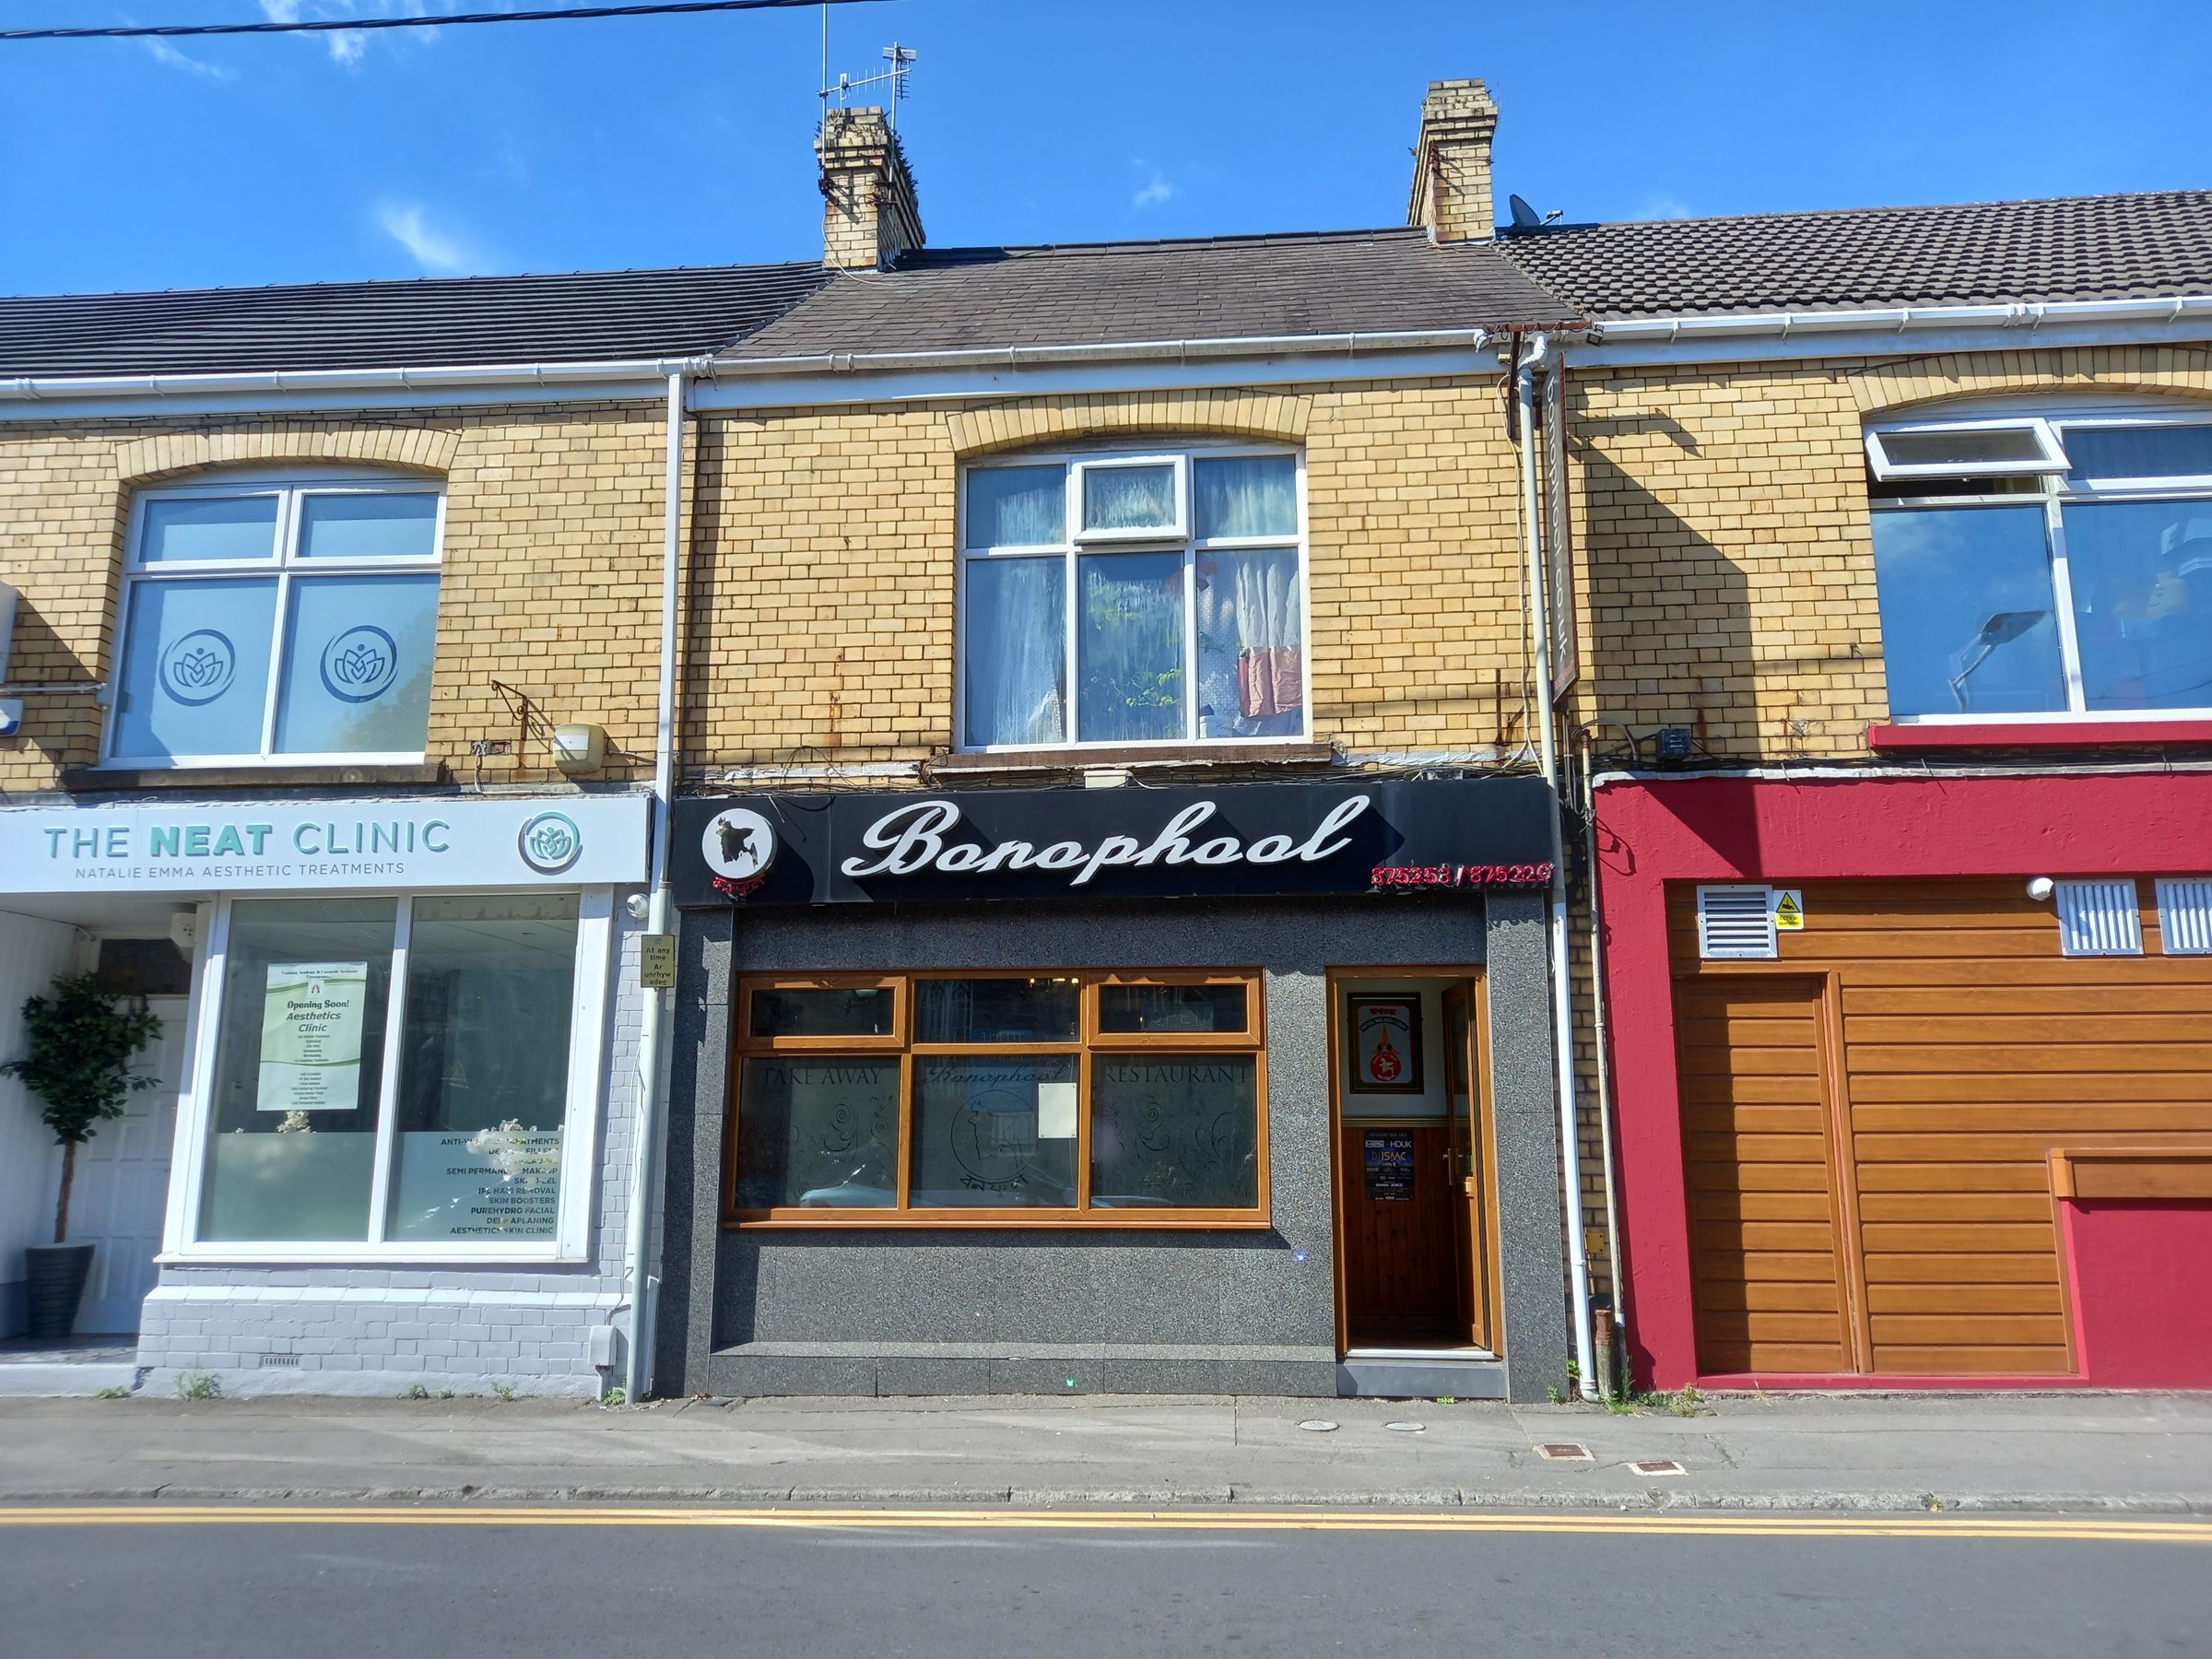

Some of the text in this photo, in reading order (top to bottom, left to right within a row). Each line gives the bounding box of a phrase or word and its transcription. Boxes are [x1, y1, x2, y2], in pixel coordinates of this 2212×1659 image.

[43, 820, 451, 859] THE NEAT CLINIC
[841, 794, 1371, 887] Bonophool
[76, 863, 405, 878] NATALIE EMMA AESTHETIC TREATMENTS
[287, 999, 350, 1010] Opening Soon!
[286, 1011, 342, 1021] Aesthetics
[298, 1023, 328, 1032] Clinic
[760, 1067, 883, 1085] TAKE AWAY
[1105, 1064, 1251, 1083] RESTAURANT
[446, 1167, 466, 1175] SEMI
[470, 1206, 523, 1215] PUREHYDRO
[525, 1226, 554, 1234] CLINIC
